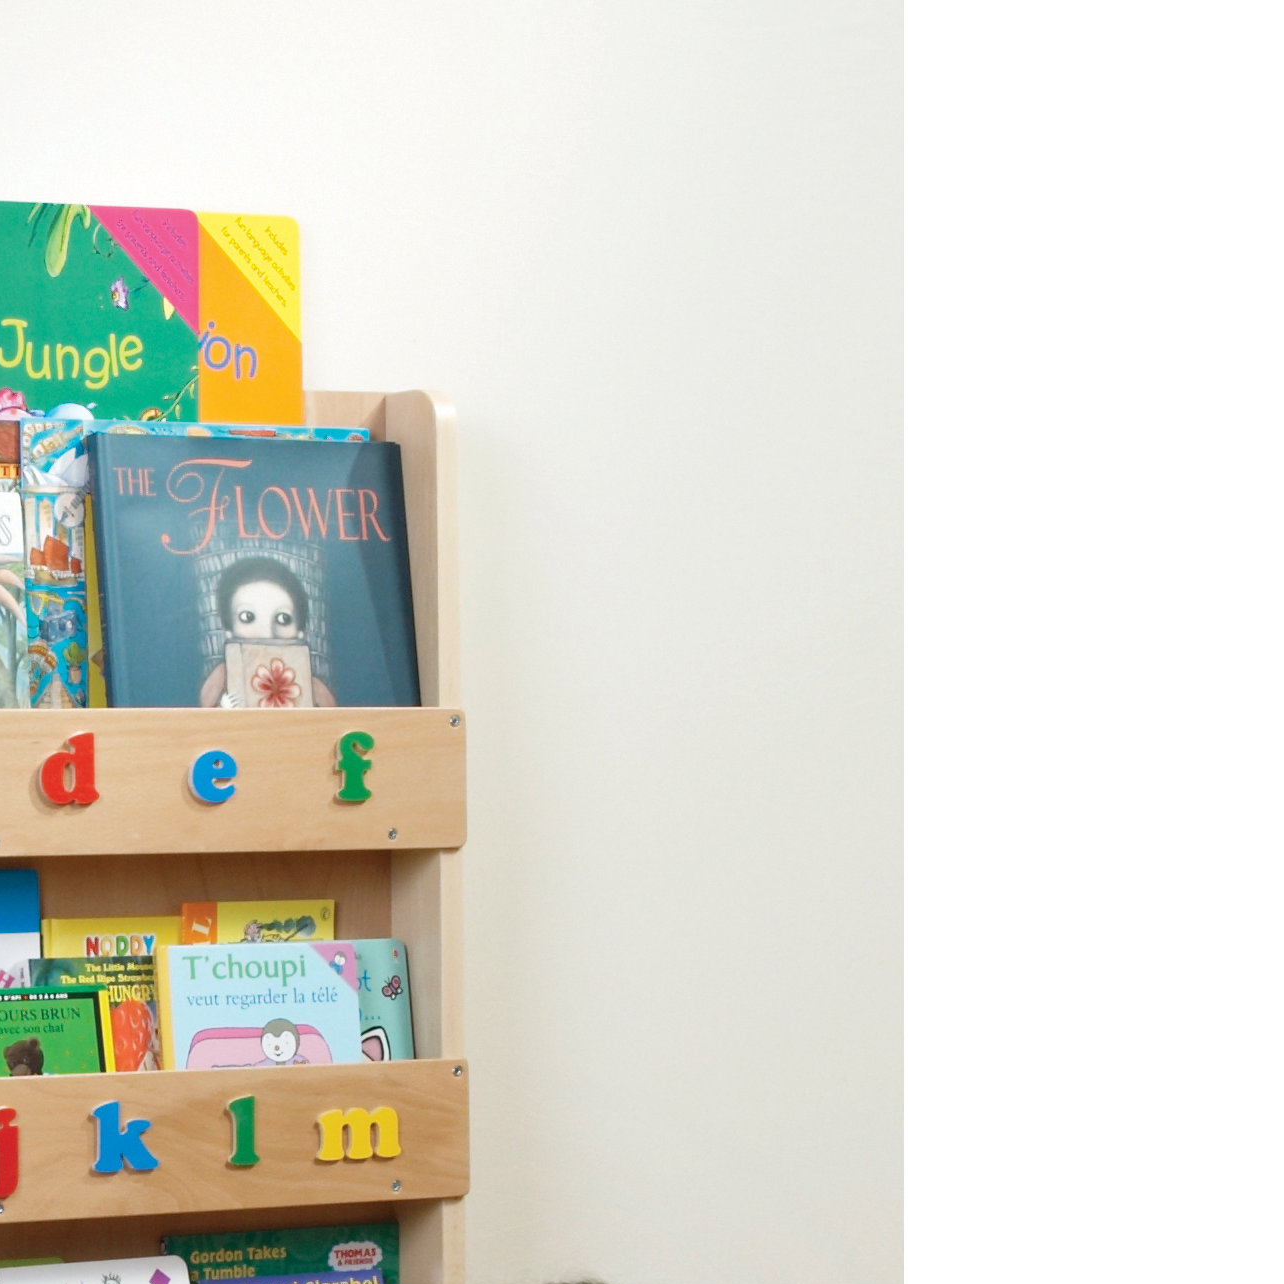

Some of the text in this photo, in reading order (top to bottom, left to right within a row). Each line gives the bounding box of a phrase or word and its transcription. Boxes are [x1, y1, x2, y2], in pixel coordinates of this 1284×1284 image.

[113, 456, 392, 556] THE FLOWER
[38, 731, 100, 806] d
[187, 750, 239, 804] e
[333, 730, 376, 803] f
[85, 934, 156, 957] NODDY
[60, 974, 77, 986] The
[182, 953, 306, 987] T'choupi
[186, 986, 339, 1010] veut regarder la télé
[40, 1007, 81, 1021] BRUN
[22, 1026, 41, 1034] son
[42, 1022, 65, 1034] chat
[90, 1101, 160, 1174] k
[226, 1095, 261, 1168] l
[316, 1105, 402, 1162] m
[190, 1245, 287, 1265] Gordon Takes
[333, 1247, 377, 1260] THOMAS
[191, 1264, 256, 1282] a Tumble
